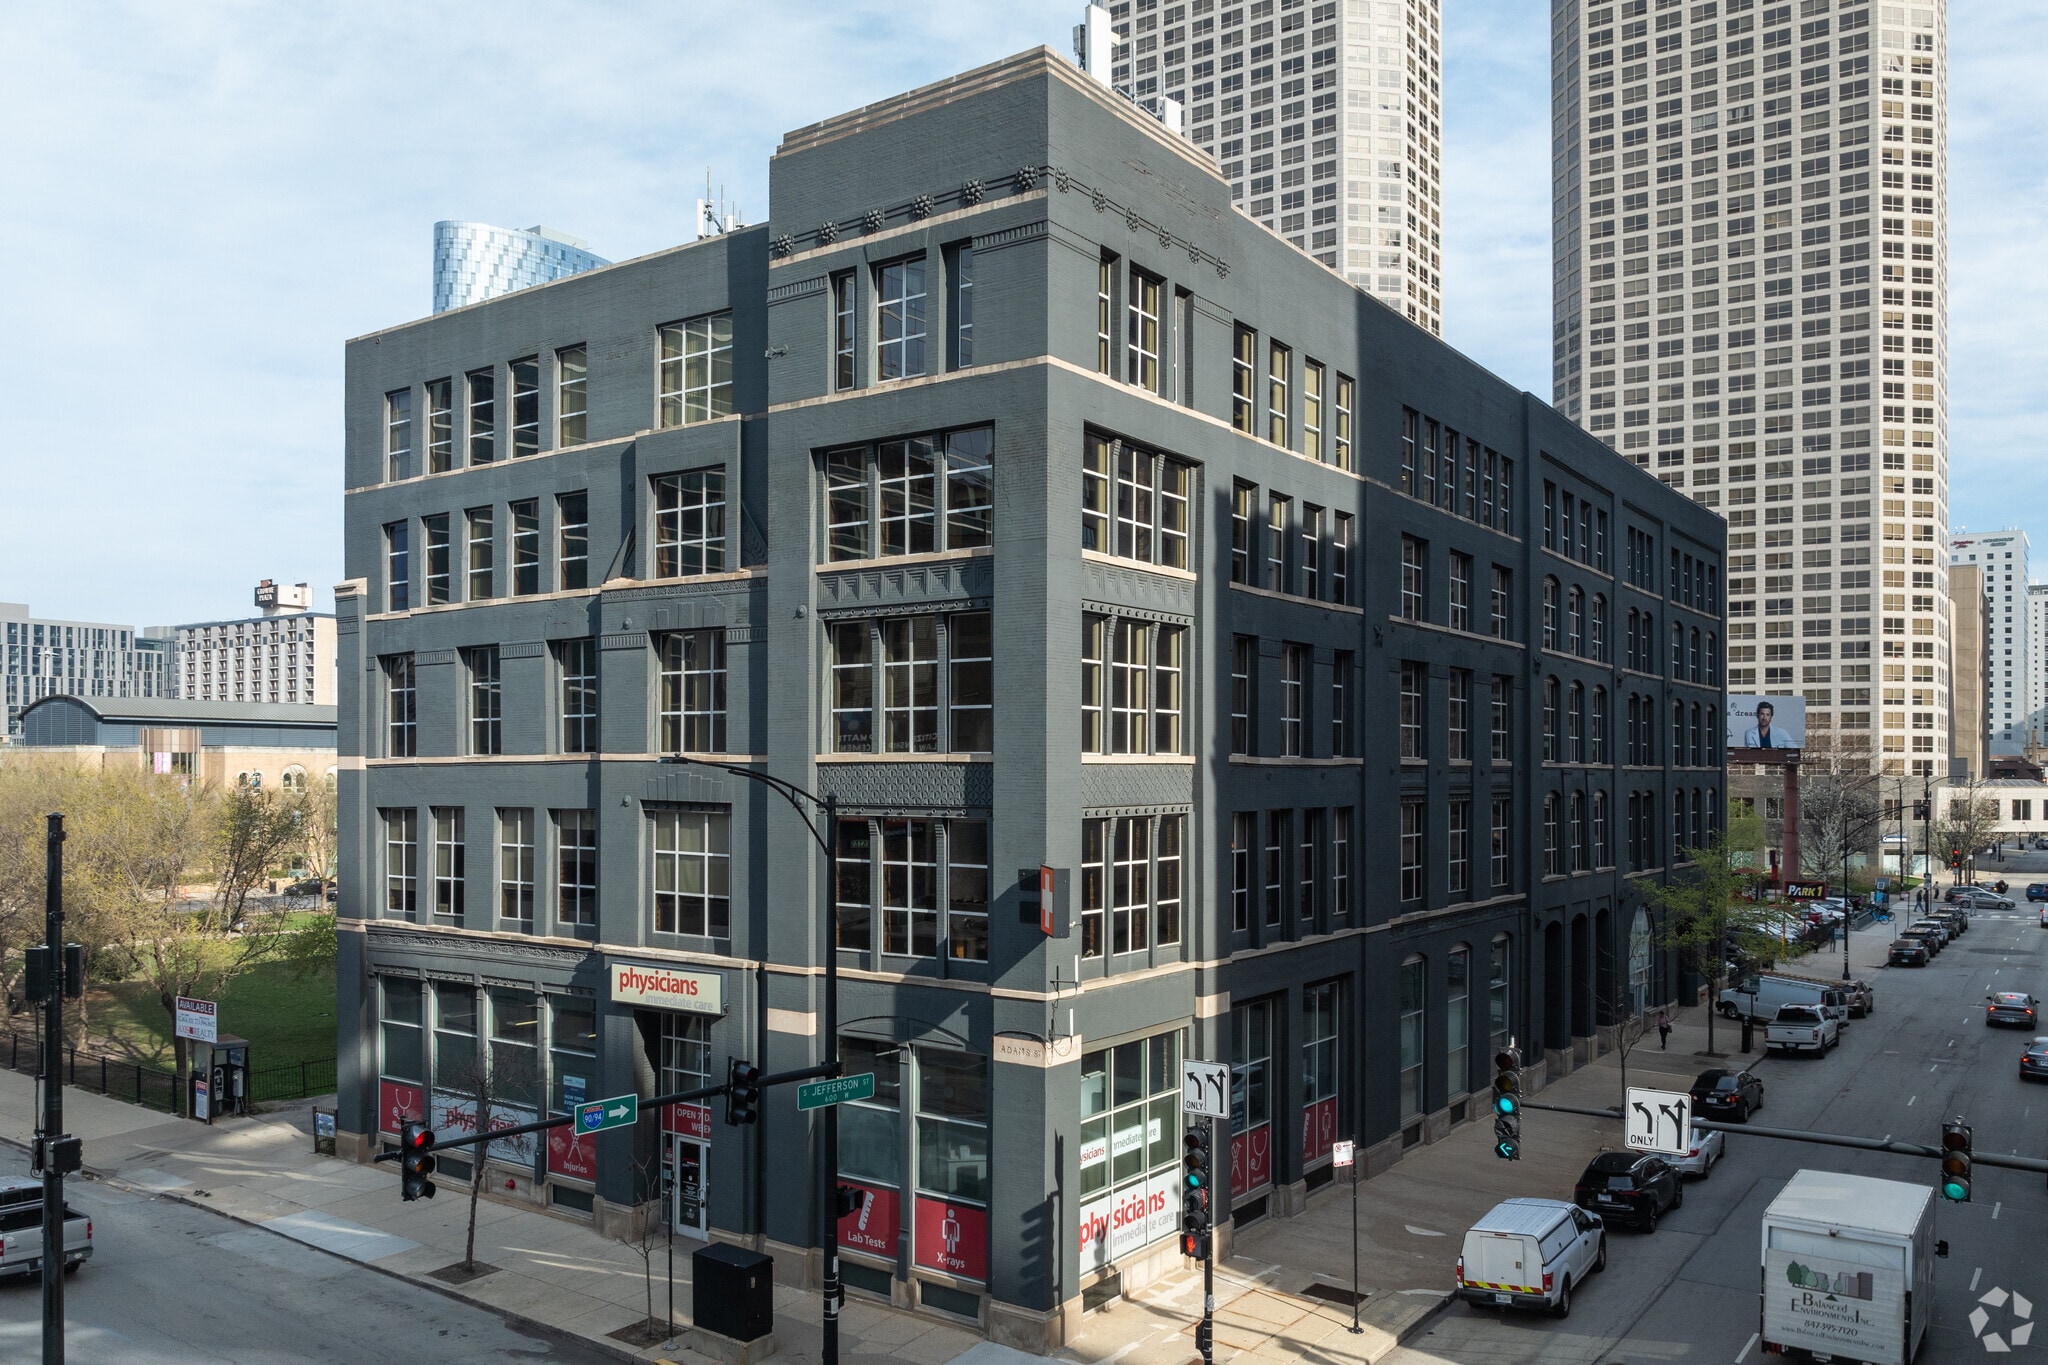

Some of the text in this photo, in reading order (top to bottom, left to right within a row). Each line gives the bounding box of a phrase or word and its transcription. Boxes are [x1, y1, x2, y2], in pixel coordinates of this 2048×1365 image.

[1788, 884, 1823, 897] PARK 1
[619, 967, 698, 996] physicians
[179, 1000, 213, 1014] AVAILABLE
[645, 991, 713, 1012] immediate care
[1000, 1045, 1031, 1057] ADAMS
[803, 1078, 869, 1097] S JEFFERSON ST
[825, 1094, 837, 1103] 600
[1185, 1100, 1204, 1111] ONLY
[584, 1112, 602, 1123] 90/94
[676, 1108, 697, 1120] OPEN
[697, 1112, 702, 1121] 7
[1113, 1133, 1142, 1150] mediate
[1630, 1134, 1654, 1146] ONLY
[1079, 1147, 1105, 1165] ysicians
[563, 1160, 588, 1174] Injuries
[1079, 1190, 1165, 1253] physicians
[1113, 1212, 1174, 1247] immediate care
[847, 1230, 886, 1249] Lab Tests
[936, 1252, 965, 1269] X-rays
[1804, 1319, 1858, 1337] 847-395-7120
